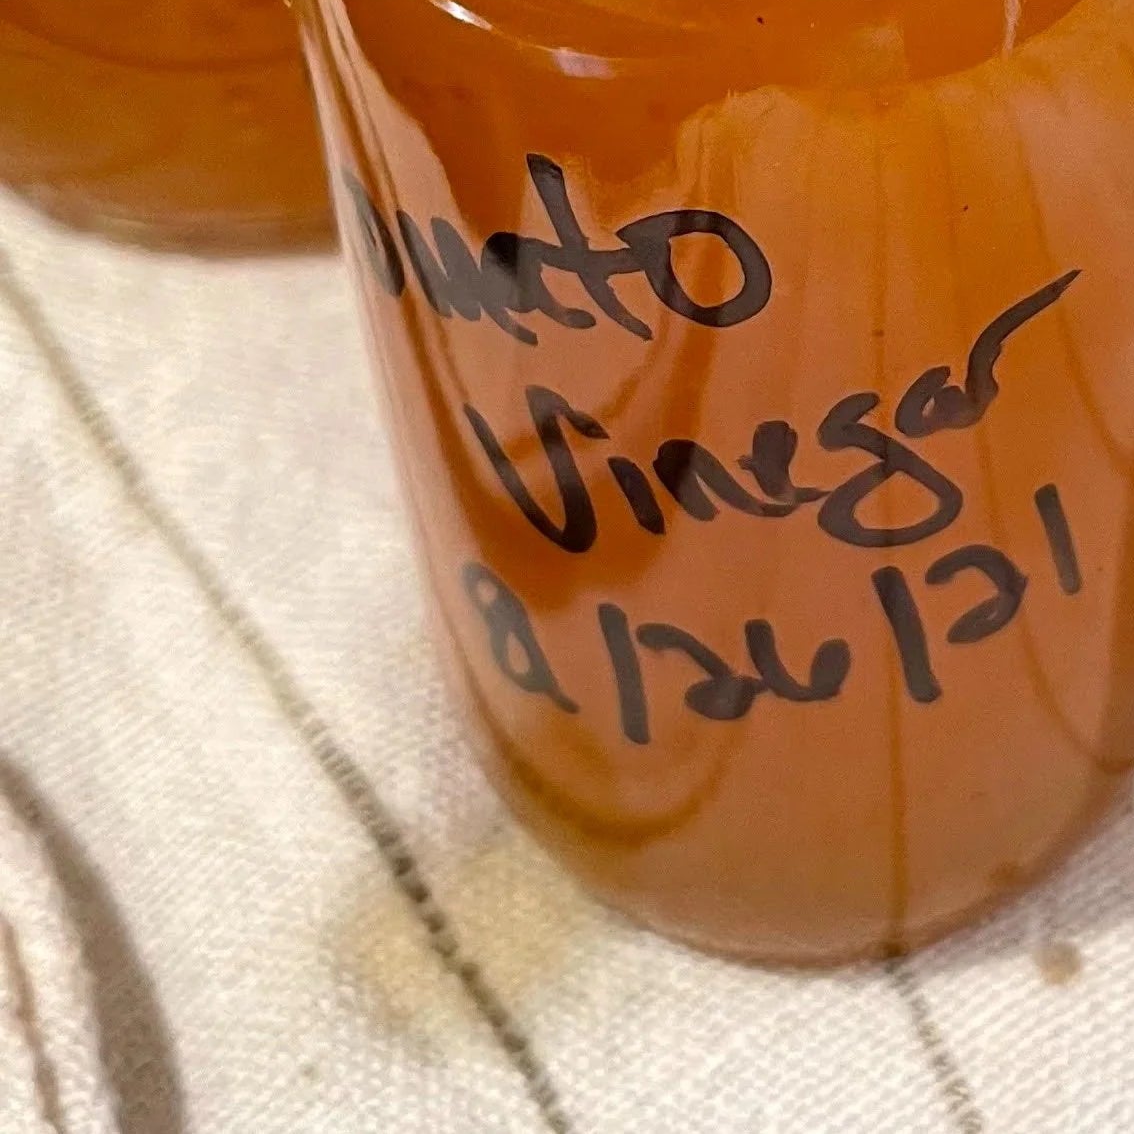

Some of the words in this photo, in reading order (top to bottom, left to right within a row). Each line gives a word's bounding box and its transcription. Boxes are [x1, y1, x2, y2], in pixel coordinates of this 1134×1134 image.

[340, 153, 773, 346] omato
[463, 269, 1083, 553] Vinegar
[462, 484, 1084, 745] 8/26/21
